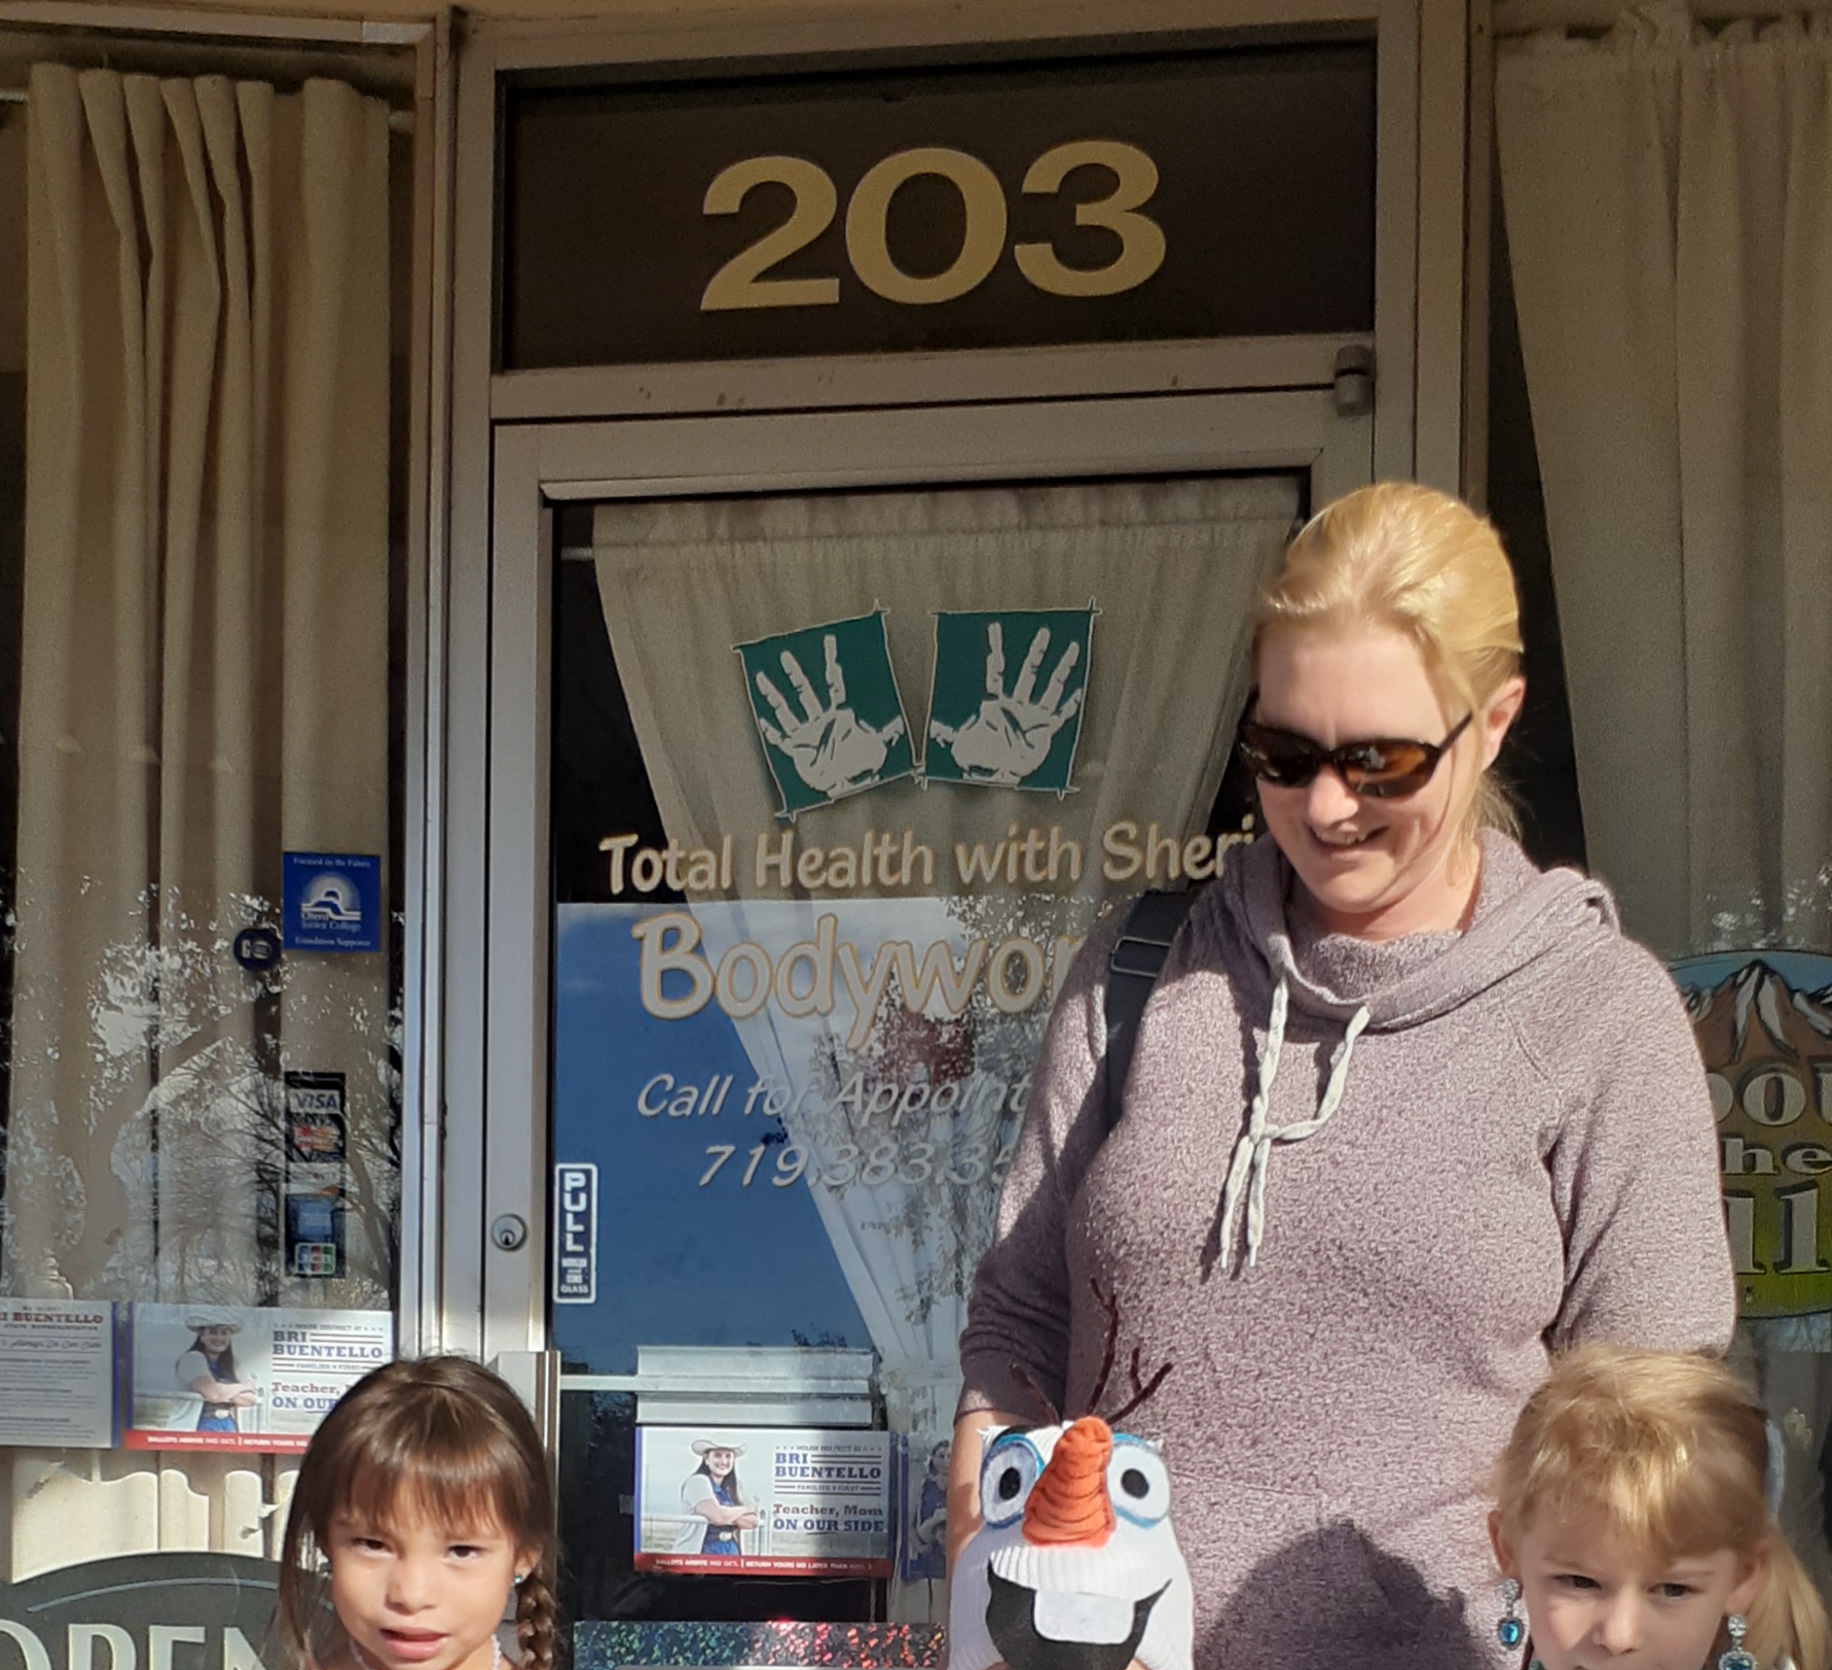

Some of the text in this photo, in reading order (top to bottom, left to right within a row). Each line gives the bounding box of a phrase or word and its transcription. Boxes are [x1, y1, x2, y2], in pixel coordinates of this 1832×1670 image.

[700, 139, 1166, 312] 203
[598, 832, 732, 895] Total
[755, 829, 934, 889] Health
[955, 822, 1082, 884] with
[293, 1092, 338, 1110] VISA
[636, 1073, 733, 1119] Call
[744, 1073, 822, 1118] for
[563, 1172, 588, 1252] PULL
[560, 1283, 589, 1294] GLASS
[12, 1312, 104, 1323] BUENTELLO
[320, 1323, 352, 1332] DISTRICT
[273, 1330, 308, 1343] BRI
[273, 1343, 384, 1359] BUENTELLO
[272, 1382, 341, 1396] Teacher,
[272, 1396, 298, 1409] ON
[775, 1452, 809, 1464] BRI
[775, 1465, 882, 1479] BUENTELLO
[773, 1503, 883, 1518] Teacher, Mom
[773, 1519, 799, 1531] ON
[803, 1519, 840, 1532] OUR
